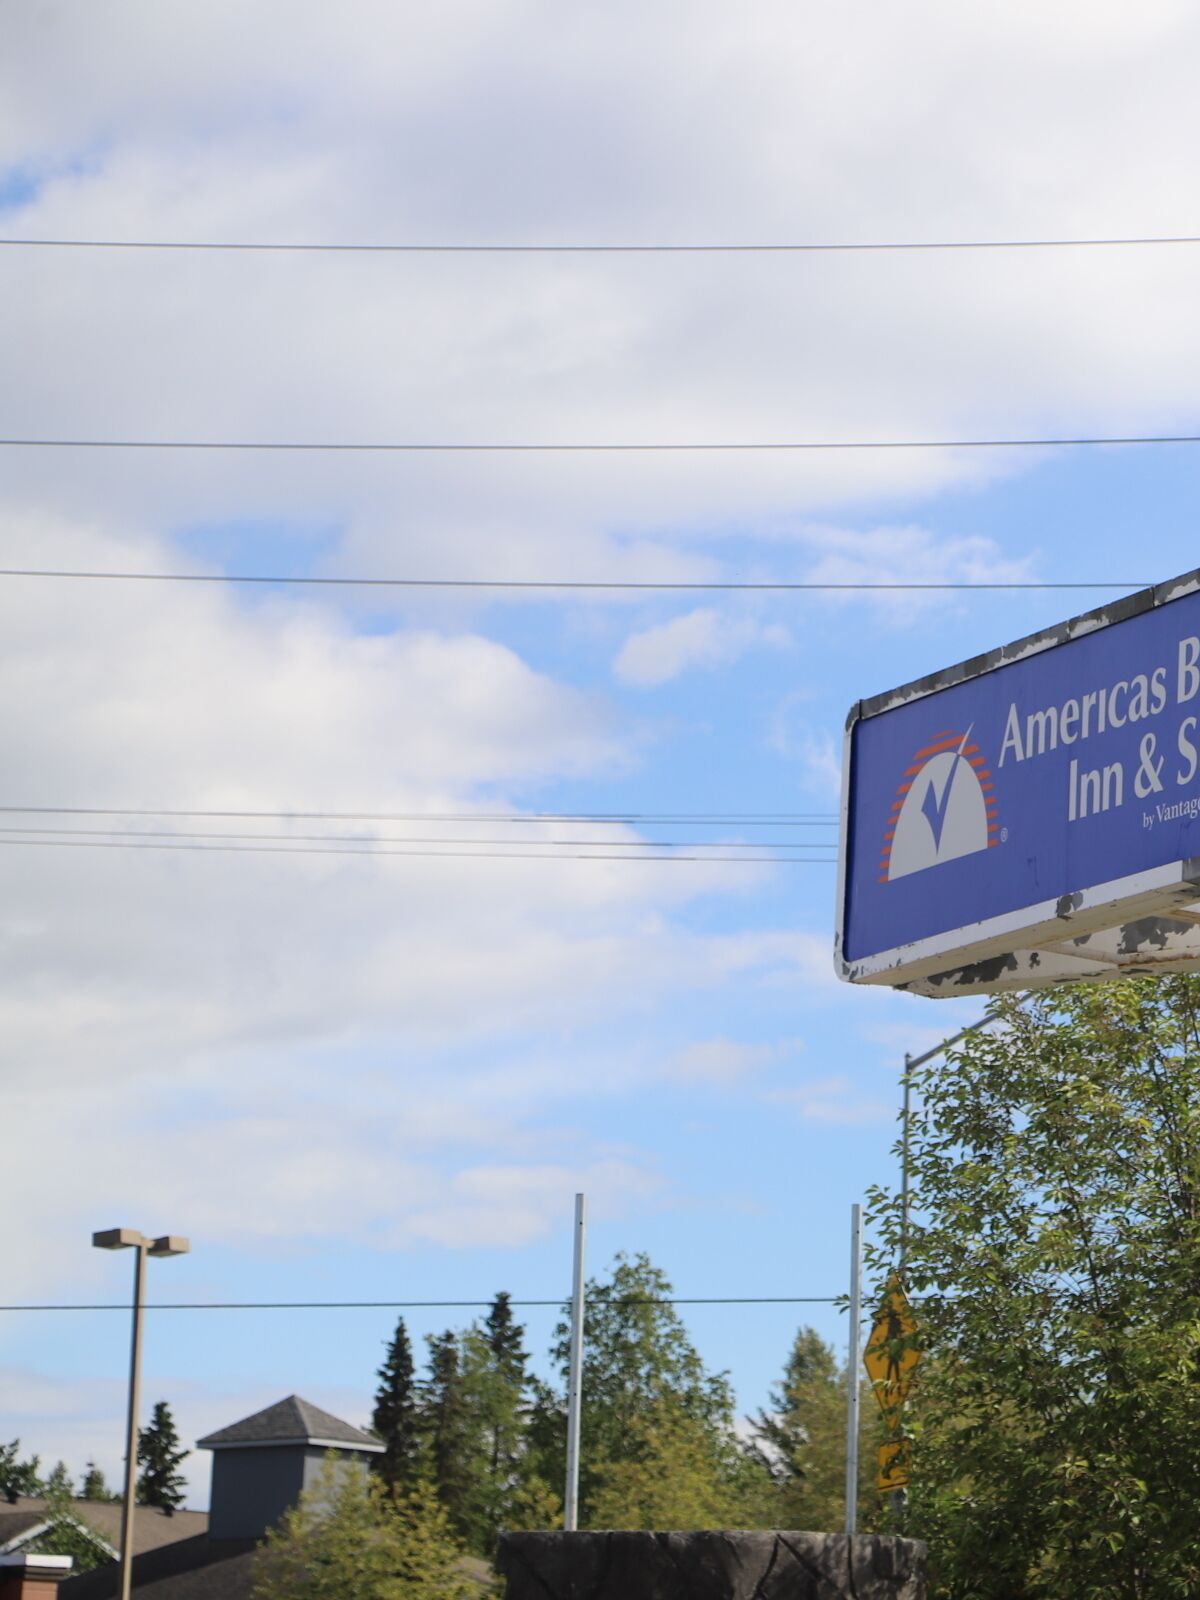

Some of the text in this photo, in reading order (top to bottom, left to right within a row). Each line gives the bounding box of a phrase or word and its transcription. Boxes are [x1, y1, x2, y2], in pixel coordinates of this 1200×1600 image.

[998, 667, 1167, 768] Americas
[1068, 759, 1123, 822] Inn
[1134, 732, 1164, 799] &
[1142, 812, 1155, 830] by
